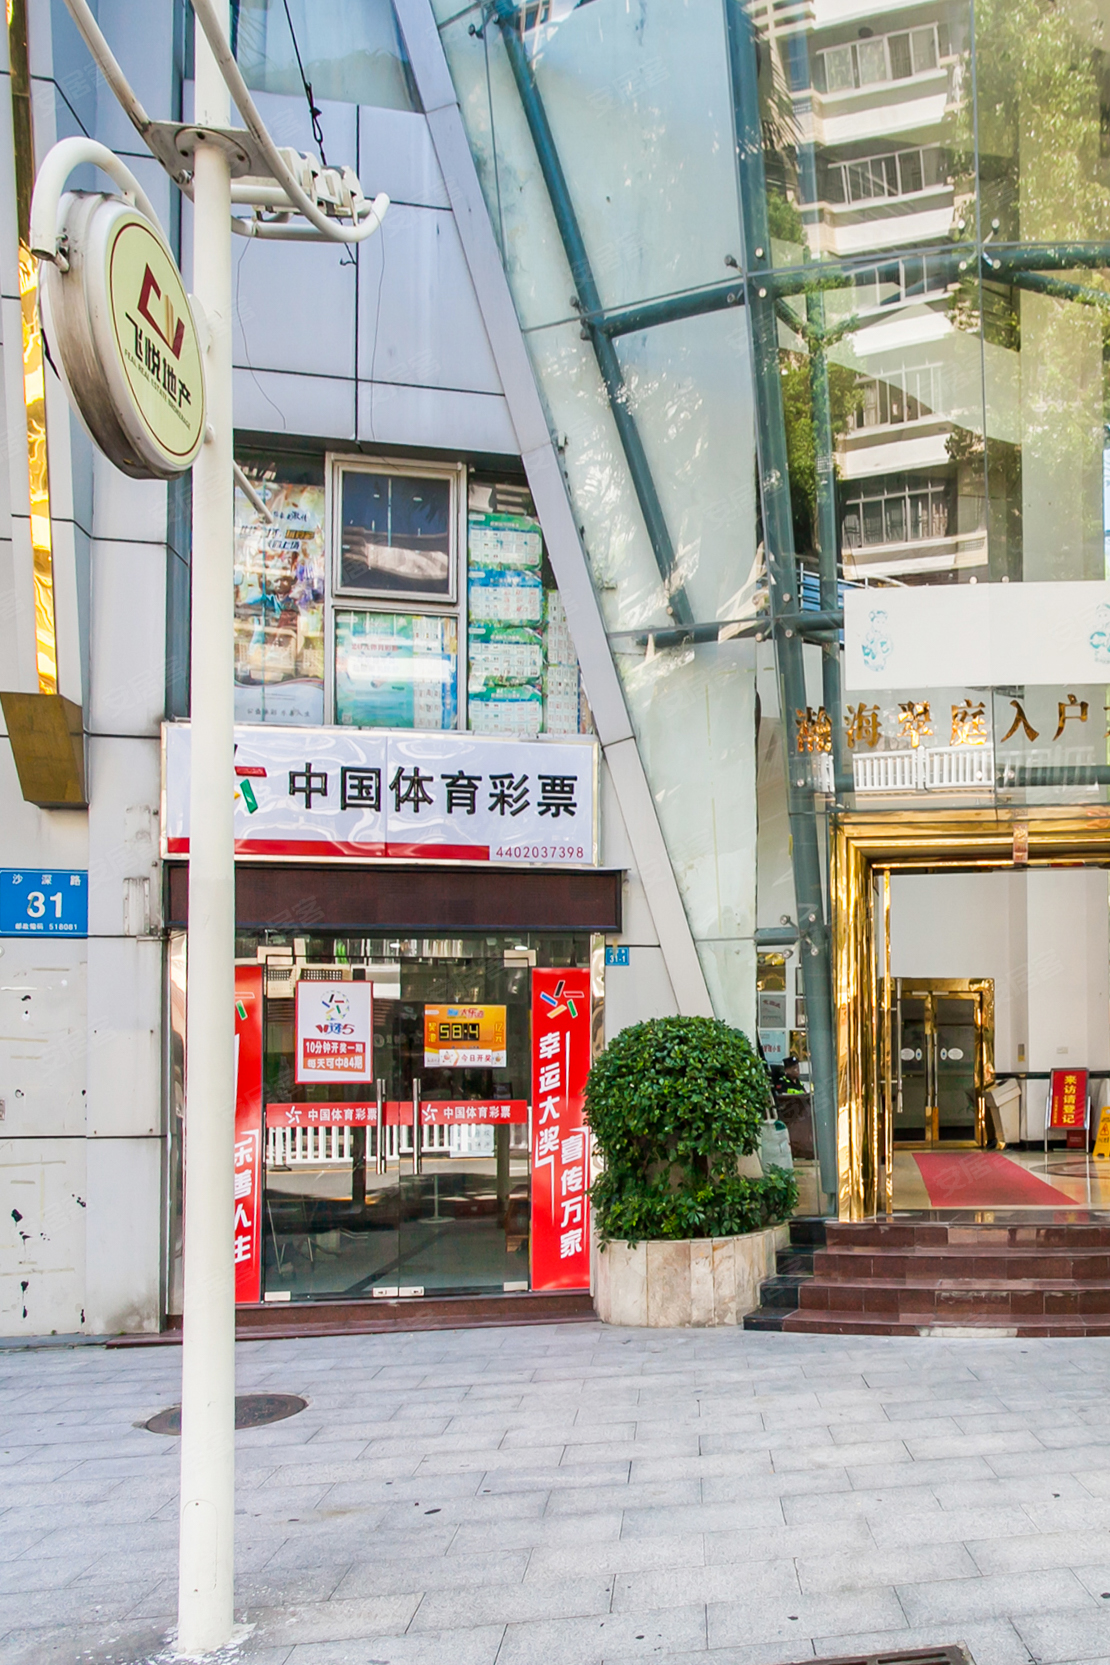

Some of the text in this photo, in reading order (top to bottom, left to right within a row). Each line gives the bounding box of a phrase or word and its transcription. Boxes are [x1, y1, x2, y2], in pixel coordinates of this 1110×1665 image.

[125, 311, 191, 409] 飞悦地产
[138, 363, 150, 383] REAL
[151, 378, 167, 402] ESTATE
[288, 762, 579, 818] 中国体育彩票
[495, 846, 585, 860] 4402037398
[12, 873, 81, 887] 沙深路
[27, 891, 63, 918] 31
[49, 923, 78, 931] 518081
[609, 954, 626, 963] 31-1
[494, 1022, 504, 1043] 亿元
[305, 1041, 364, 1054] 10分钟开奖一期
[307, 1056, 363, 1070] 每天可中84期
[461, 1054, 492, 1063] 今日开奖
[538, 1030, 561, 1157] 幸运大奖
[1062, 1075, 1077, 1124] 来访请登记
[308, 1107, 378, 1121] 中国体育彩票
[443, 1105, 511, 1120] 中国体育彩票
[560, 1132, 583, 1260] 喜传万家
